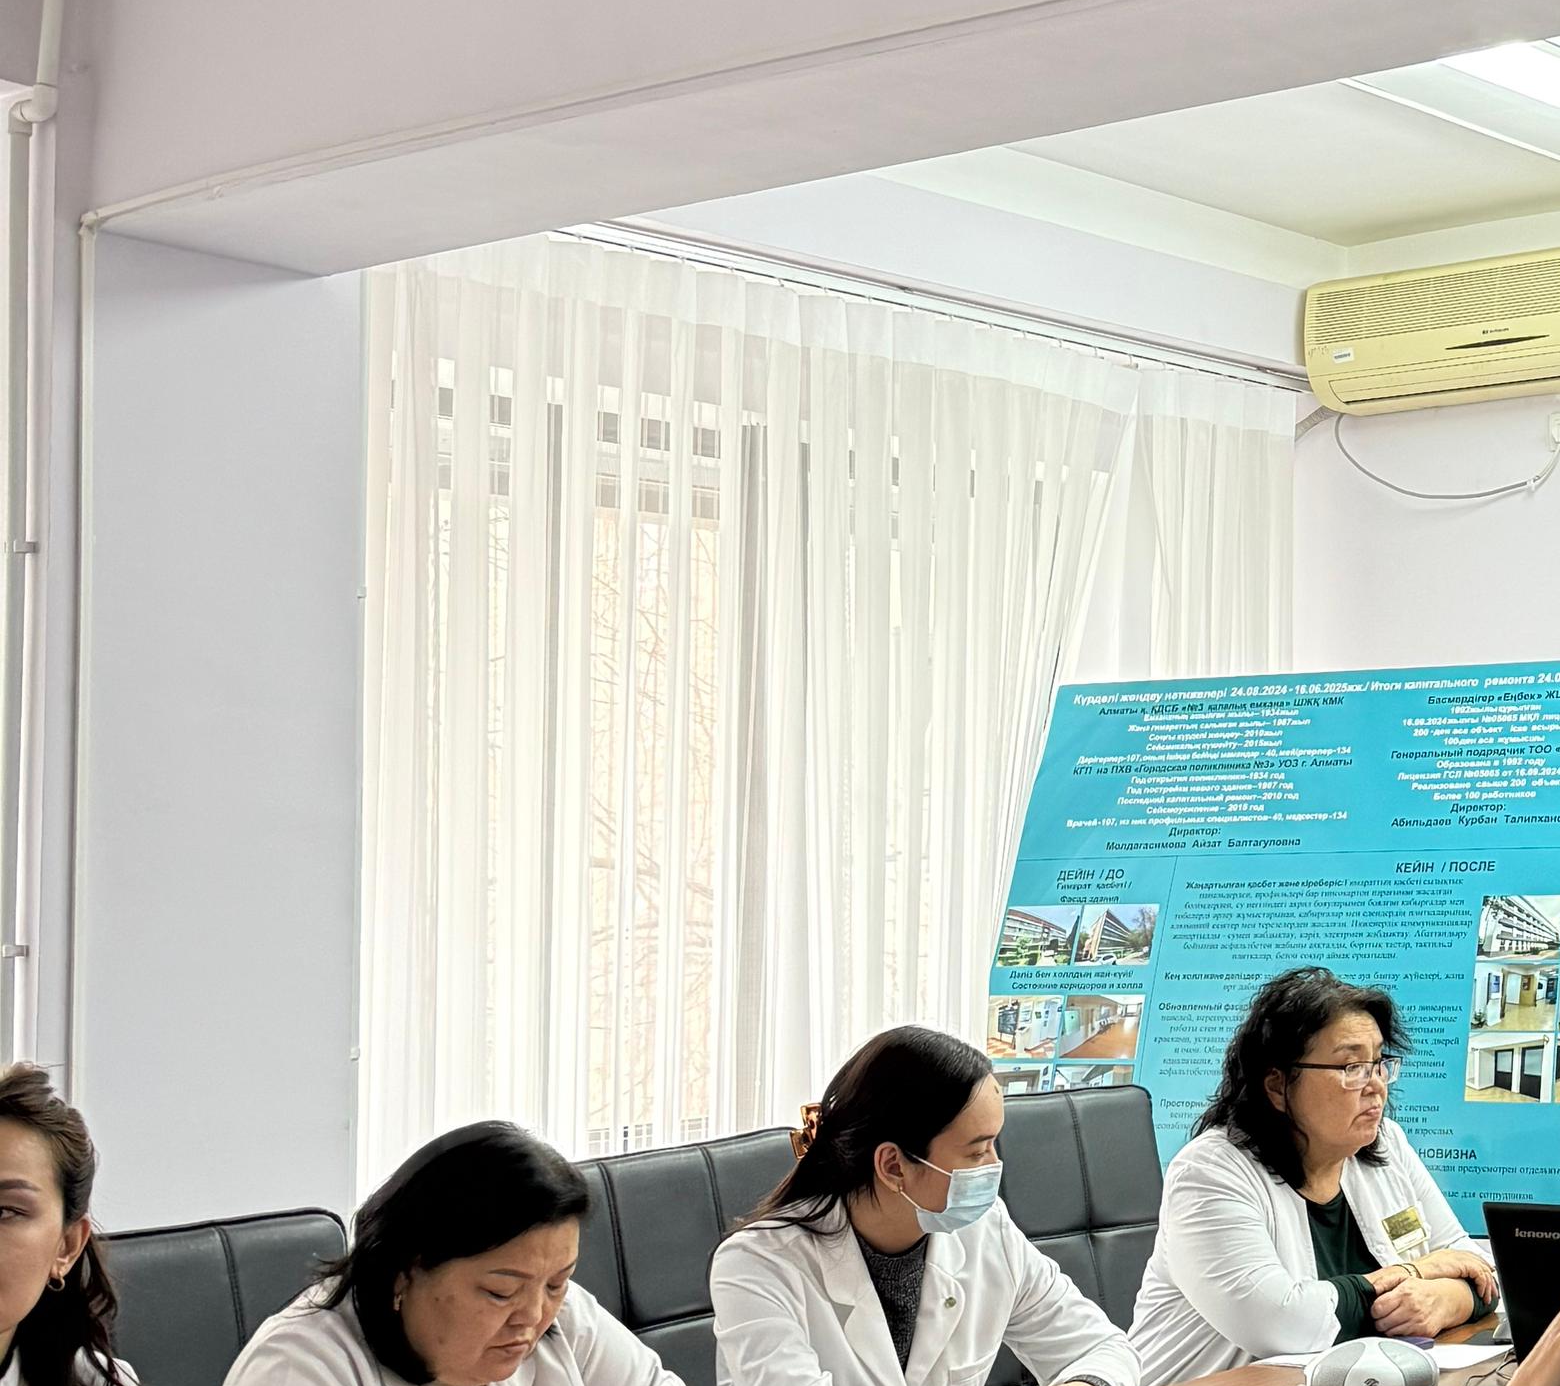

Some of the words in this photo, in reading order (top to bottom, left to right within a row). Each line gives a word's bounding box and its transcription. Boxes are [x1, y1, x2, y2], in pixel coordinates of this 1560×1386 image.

[1371, 680, 1401, 692] Итоги
[1404, 678, 1479, 690] капитального
[1484, 675, 1535, 689] ремонта
[1322, 696, 1345, 705] КМК
[1466, 746, 1525, 757] подрядчик
[1529, 744, 1552, 754] ТОО
[1111, 765, 1132, 774] ПХВ
[1189, 762, 1251, 771] поликлиника
[1278, 759, 1299, 768] УОЗ
[1310, 758, 1353, 767] Алматы
[1524, 757, 1545, 767] году
[1502, 769, 1513, 777] от
[1510, 778, 1527, 787] 200
[1433, 791, 1461, 801] Более
[1465, 791, 1480, 800] 100
[1482, 790, 1537, 800] работников
[1227, 803, 1248, 812] 2015
[1249, 803, 1264, 811] год
[1450, 803, 1507, 814] Директор:
[1458, 814, 1497, 826] Курбан
[1169, 827, 1221, 838] Директор:
[1192, 839, 1222, 848] Айзат
[1228, 838, 1301, 849] Балтагуловна
[1396, 859, 1435, 873] КЕЙІН
[1449, 860, 1496, 873] ПОСЛЕ
[1057, 869, 1095, 882] ДЕЙІН
[1105, 868, 1125, 882] ДО
[1060, 894, 1087, 904] Фасад
[1059, 981, 1107, 991] коридоров
[1116, 981, 1143, 989] холла
[1158, 1001, 1223, 1011] Обновленный
[1419, 1148, 1477, 1160] НОВИЗНА
[1514, 1227, 1560, 1241] lenovo
